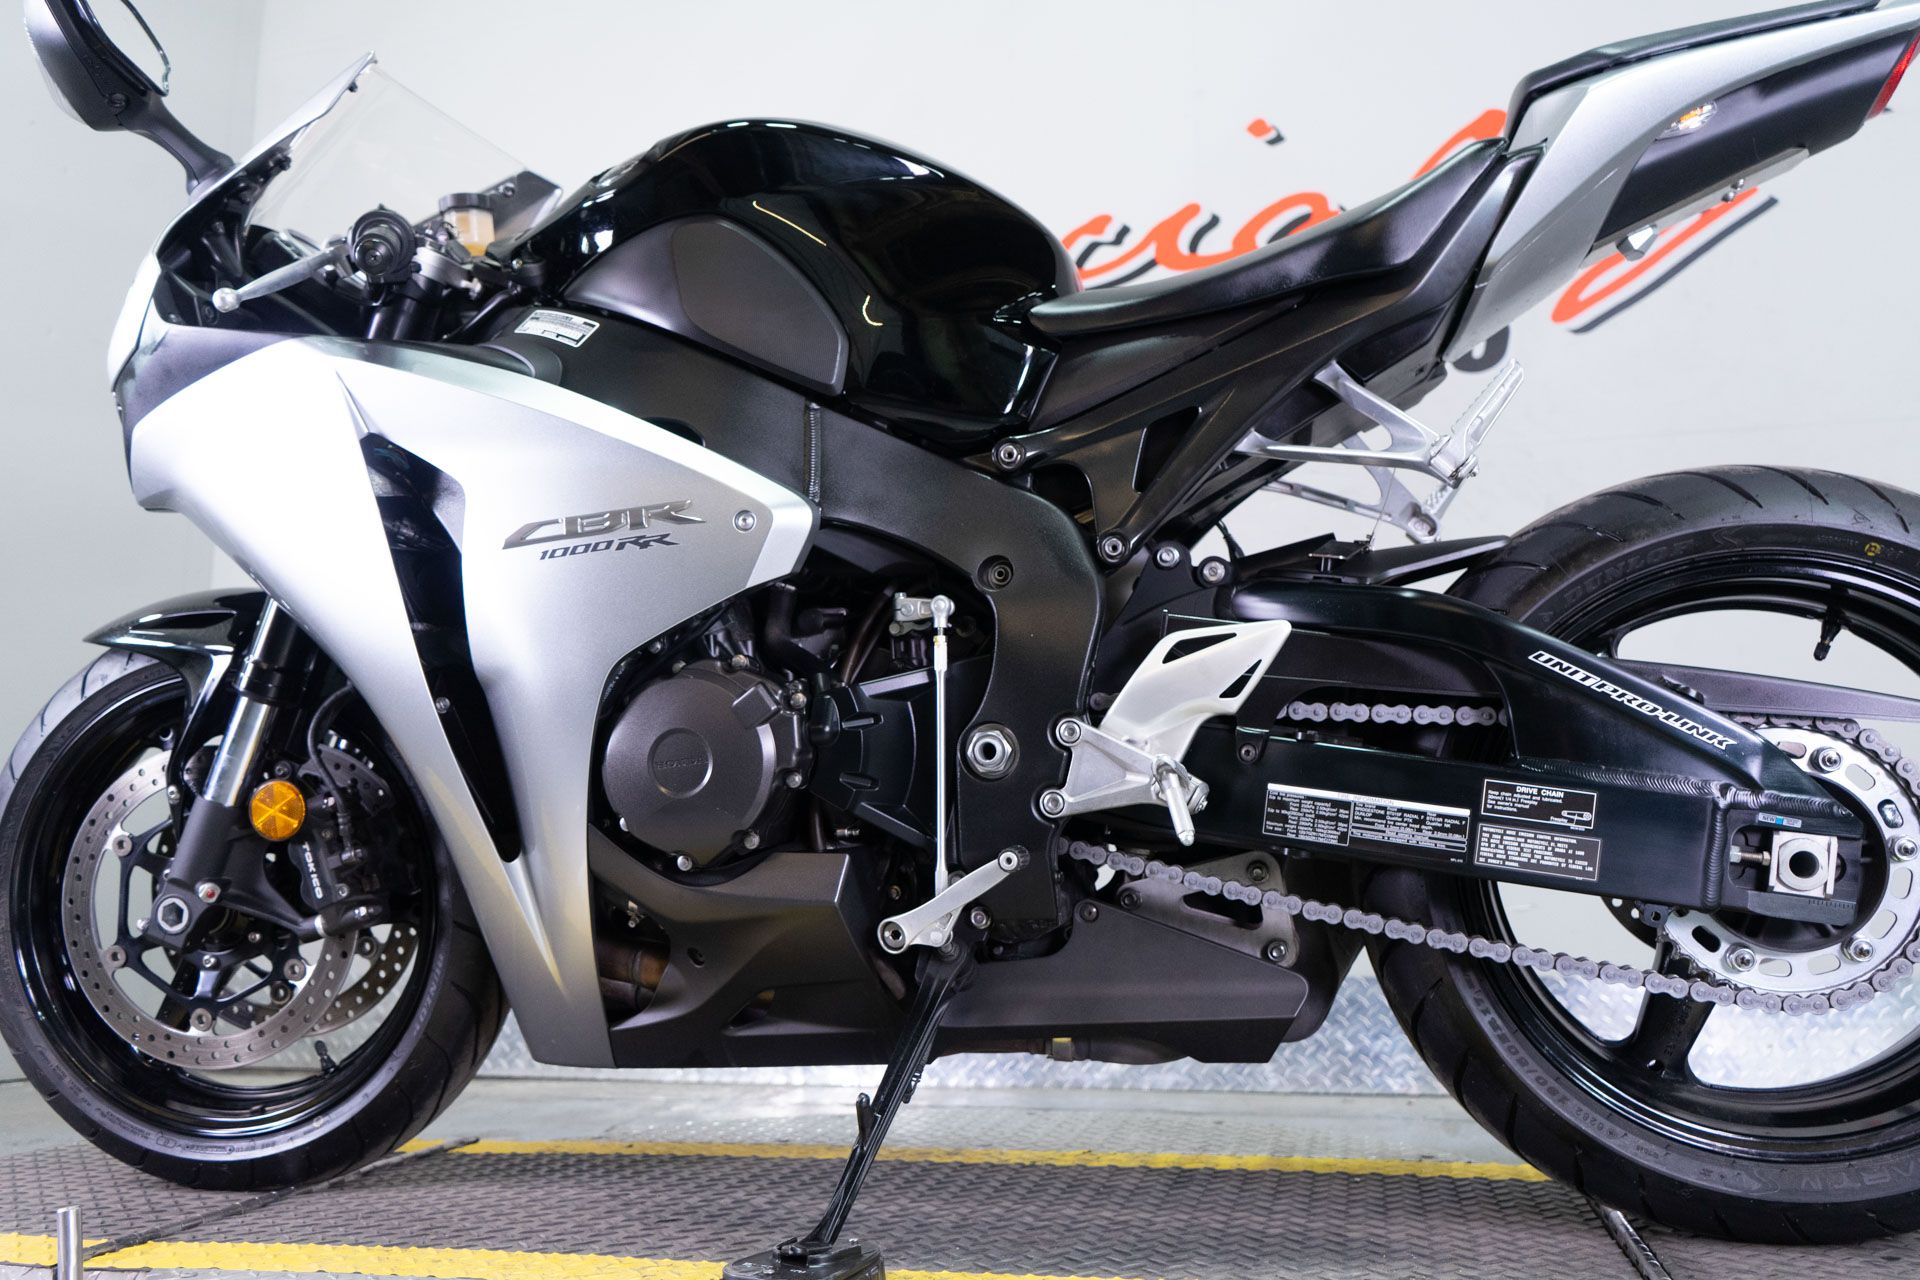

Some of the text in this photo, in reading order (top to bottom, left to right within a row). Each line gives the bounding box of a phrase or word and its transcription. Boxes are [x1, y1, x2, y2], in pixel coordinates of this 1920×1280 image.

[502, 499, 706, 549] CBR
[540, 533, 680, 560] 1000RR
[1528, 650, 1738, 750] UNIT PRO-LINK
[1516, 787, 1564, 799] DRIVE CHAIN
[302, 841, 324, 900] TOKICO
